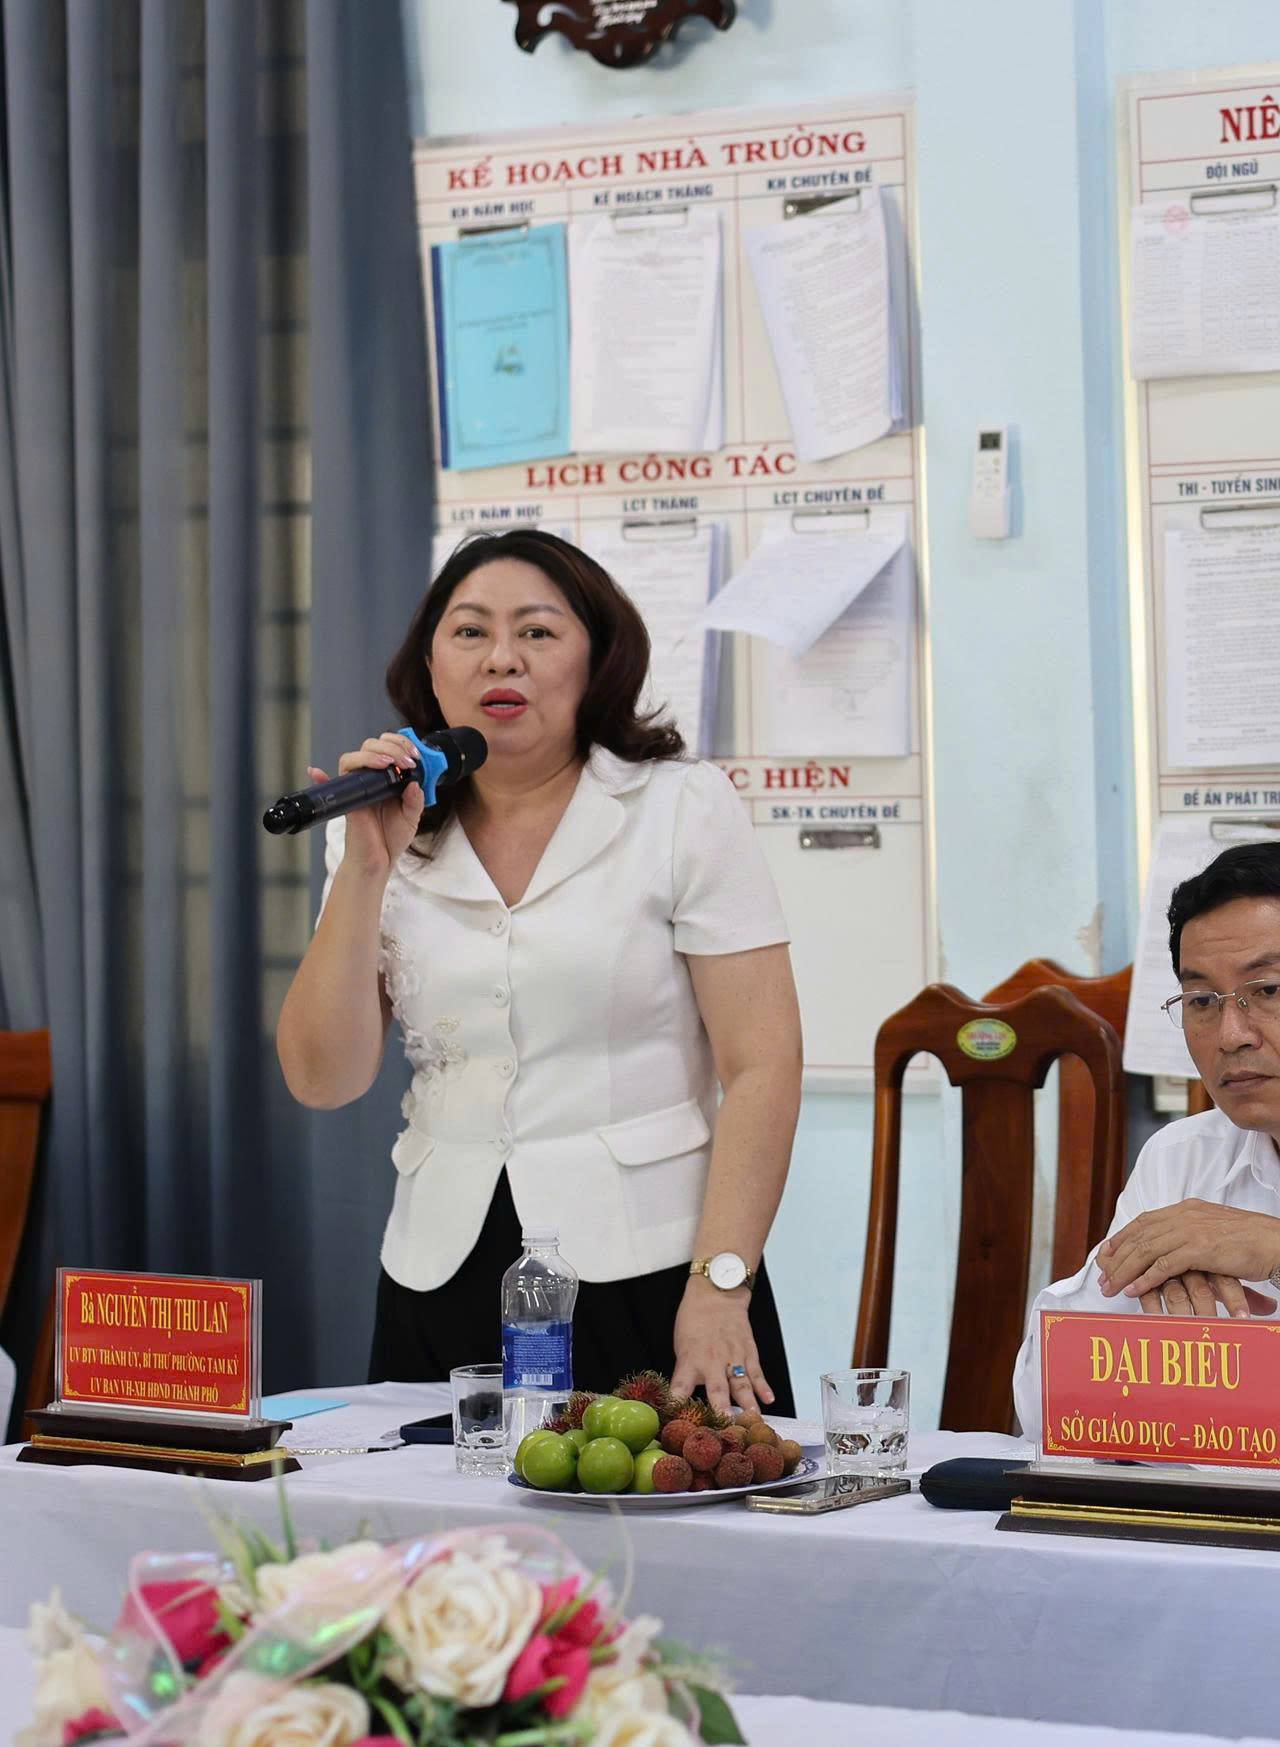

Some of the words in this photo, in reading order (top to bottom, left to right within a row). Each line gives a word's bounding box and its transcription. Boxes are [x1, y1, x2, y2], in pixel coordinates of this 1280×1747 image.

[448, 155, 494, 191] KẾ
[637, 138, 709, 173] NHÀ
[721, 124, 868, 166] TRƯỜNG
[767, 177, 787, 191] KH
[791, 168, 849, 189] CHUYÊN
[1206, 163, 1228, 181] ĐỘI
[526, 462, 606, 491] LỊCH
[619, 453, 713, 482] CÔNG
[726, 444, 797, 477] TÁC
[774, 492, 800, 505] LCT
[804, 486, 862, 504] CHUYÊN
[1178, 481, 1199, 496] THI
[622, 498, 646, 513] LCT
[764, 759, 852, 794] HIỆN
[1226, 788, 1259, 805] PHÁT
[820, 803, 877, 819] CHUYÊN
[80, 1291, 95, 1324] Bà
[97, 1285, 148, 1328] NGUYỄN
[150, 1296, 172, 1339] THỊ
[174, 1298, 200, 1332] THU
[203, 1300, 229, 1334] LAN
[69, 1346, 81, 1362] UV
[82, 1347, 98, 1364] BTV
[100, 1345, 126, 1366] THÀNH
[143, 1348, 152, 1368] BÍ
[153, 1351, 172, 1370] THƯ
[172, 1351, 206, 1373] PHƯỜNG
[207, 1357, 226, 1374] TAM
[1089, 1335, 1151, 1398] ĐẠI
[1159, 1326, 1243, 1390] BIỂU
[90, 1377, 102, 1393] UV
[103, 1378, 120, 1394] BAN
[120, 1379, 146, 1397] VH-XH
[147, 1381, 171, 1399] HĐND
[171, 1380, 200, 1402] THÀNH
[201, 1382, 219, 1403] PHỐ
[1060, 1409, 1086, 1442] SỞ
[1088, 1411, 1135, 1446] GIÁO
[1138, 1421, 1176, 1453] DỤC
[1193, 1417, 1234, 1451] ĐÀO
[1237, 1426, 1277, 1460] TẠO
